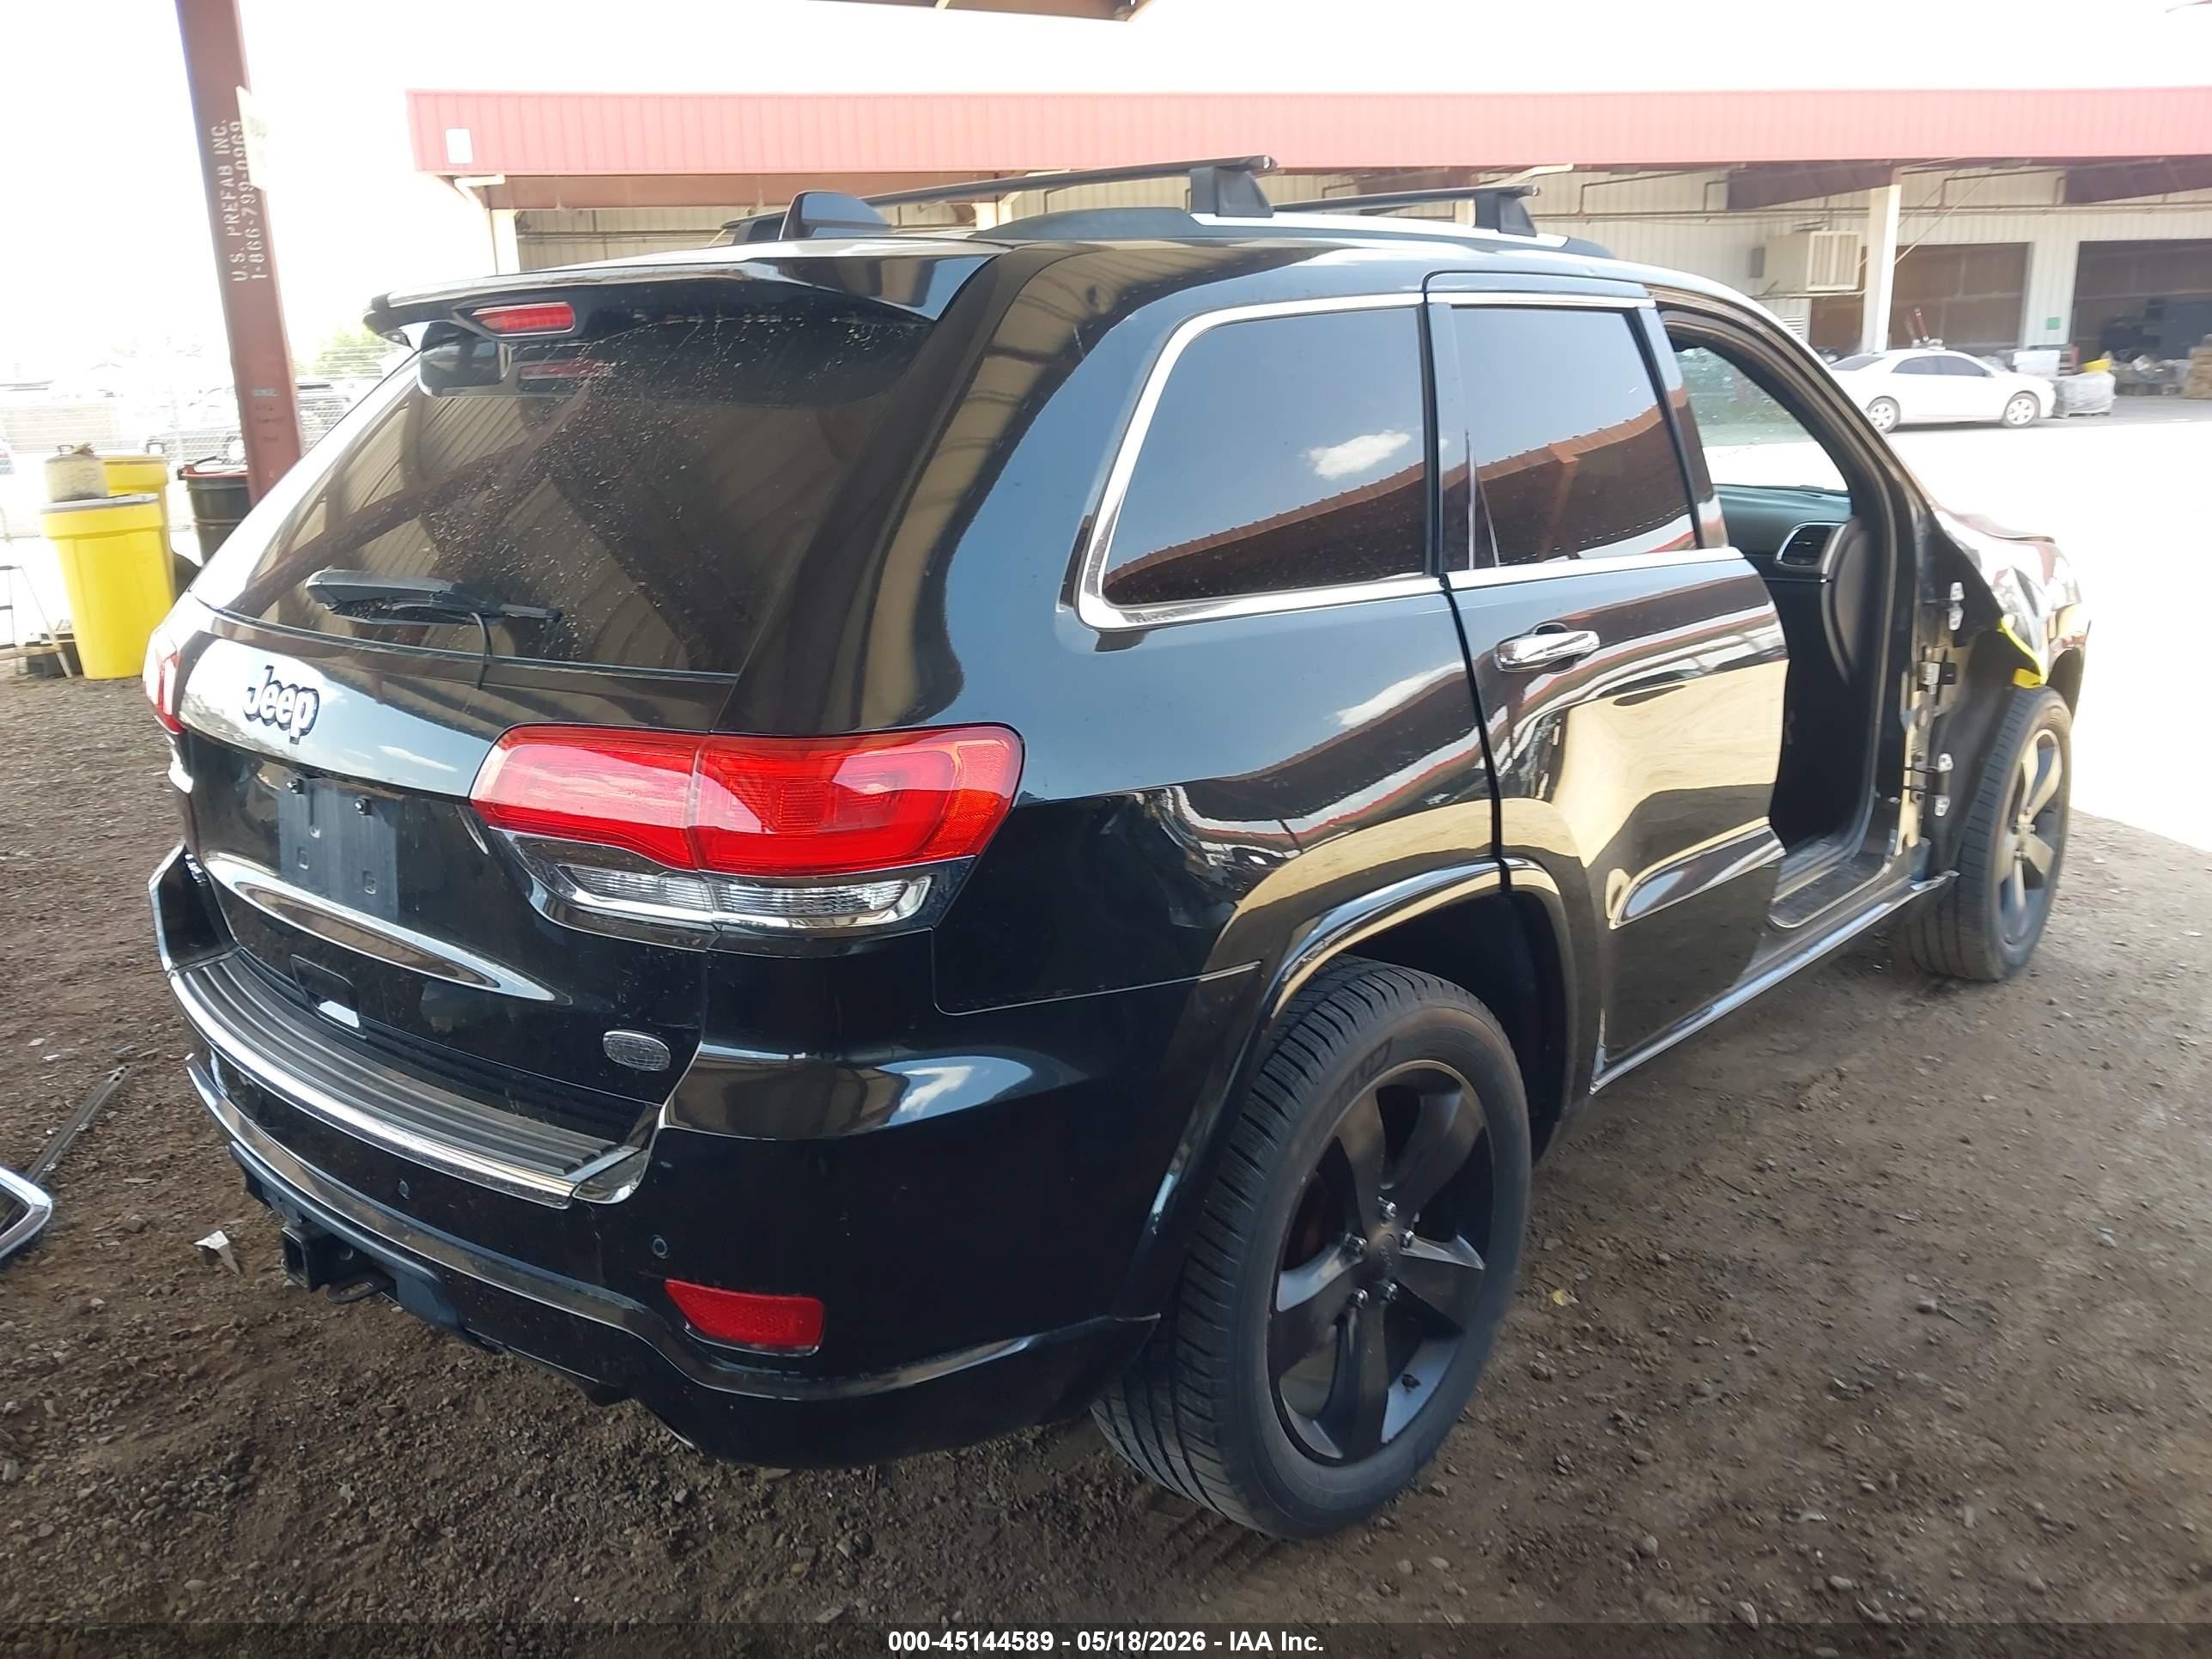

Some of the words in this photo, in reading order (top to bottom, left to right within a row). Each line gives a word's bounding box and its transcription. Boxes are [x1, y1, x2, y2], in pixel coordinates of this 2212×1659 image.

[210, 118, 230, 155] INC.
[216, 165, 242, 236] PREFAB
[229, 247, 248, 282] U.S.
[243, 665, 319, 744] Jeep
